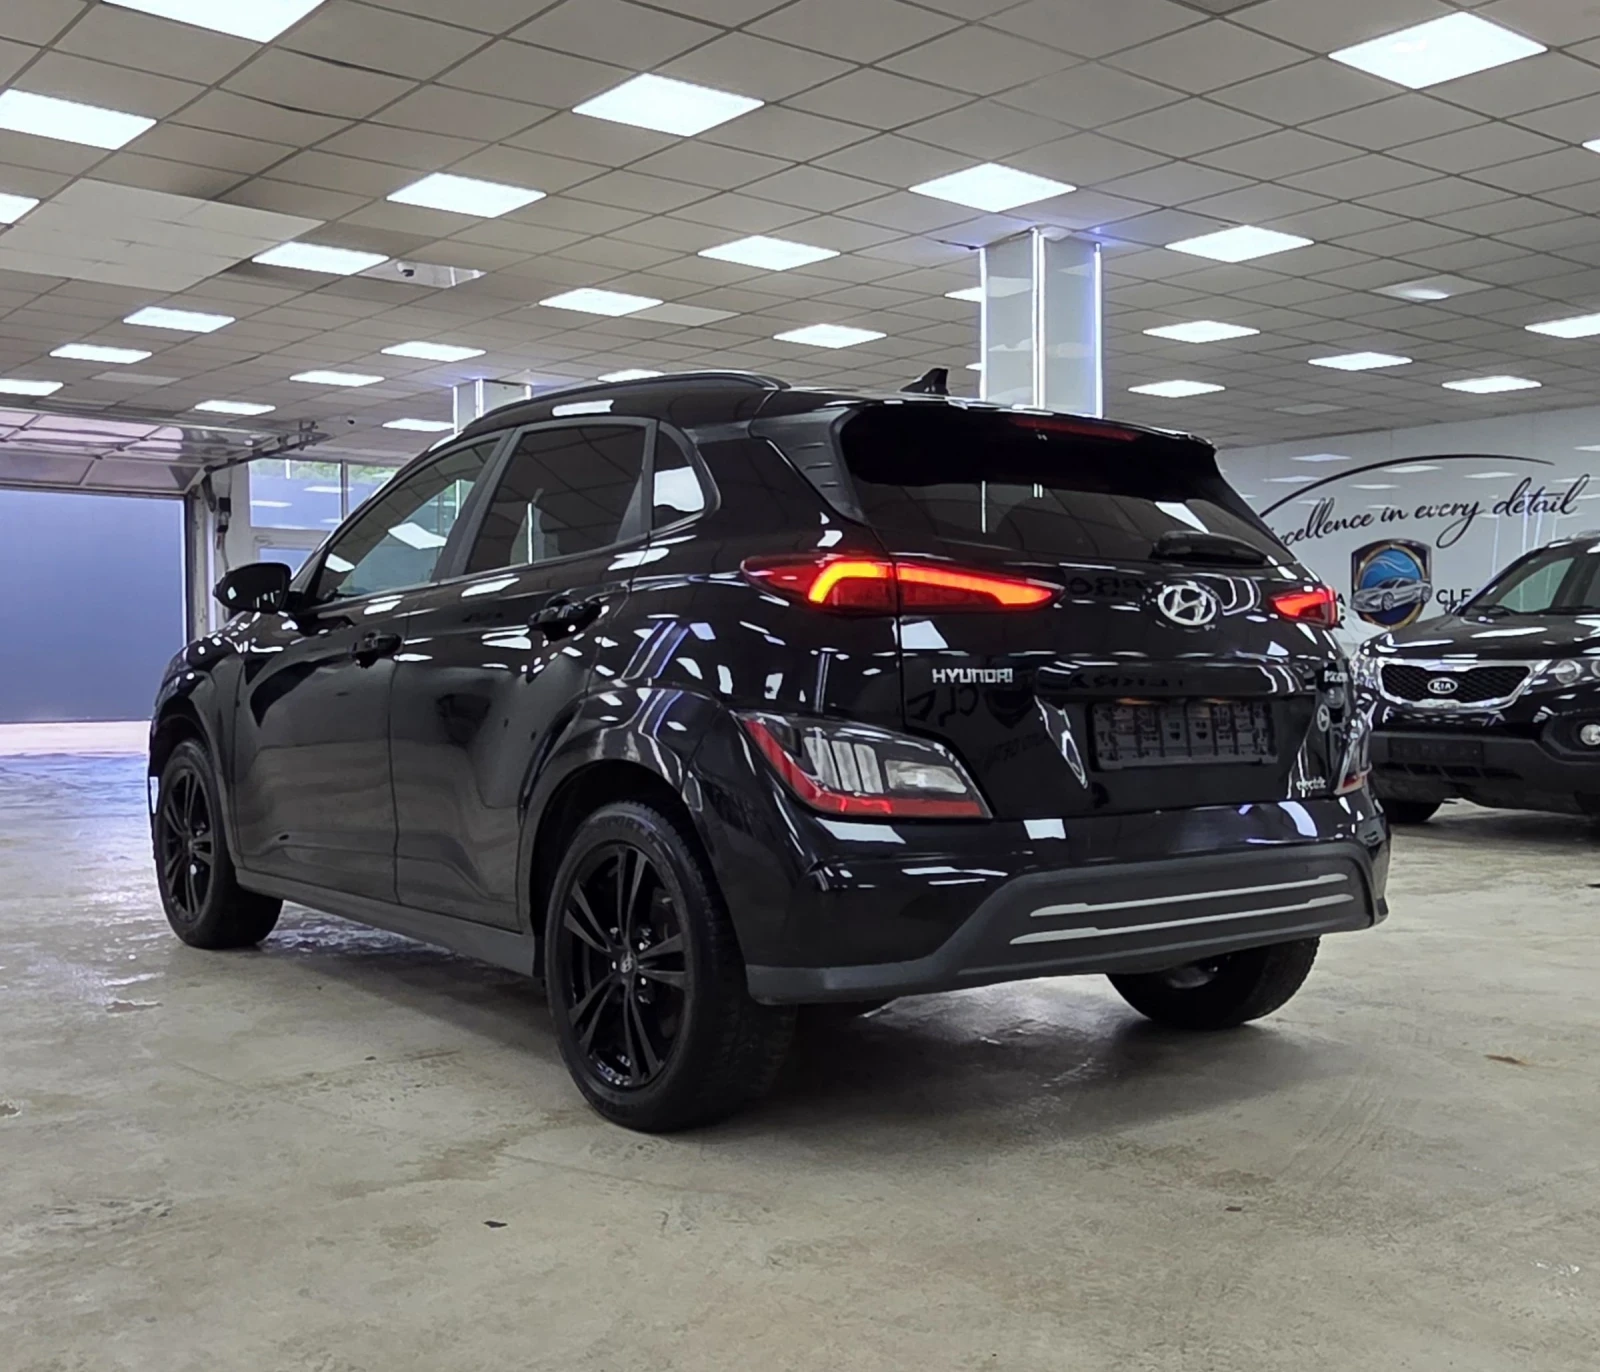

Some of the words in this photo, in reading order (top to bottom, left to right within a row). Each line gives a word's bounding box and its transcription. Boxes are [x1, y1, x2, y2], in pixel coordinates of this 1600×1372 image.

[1271, 497, 1375, 546] cellence
[1380, 504, 1408, 523] in
[1415, 500, 1486, 549] every
[1492, 473, 1591, 517] detail
[931, 667, 1014, 684] HYUNDAI
[1433, 681, 1452, 691] KIA
